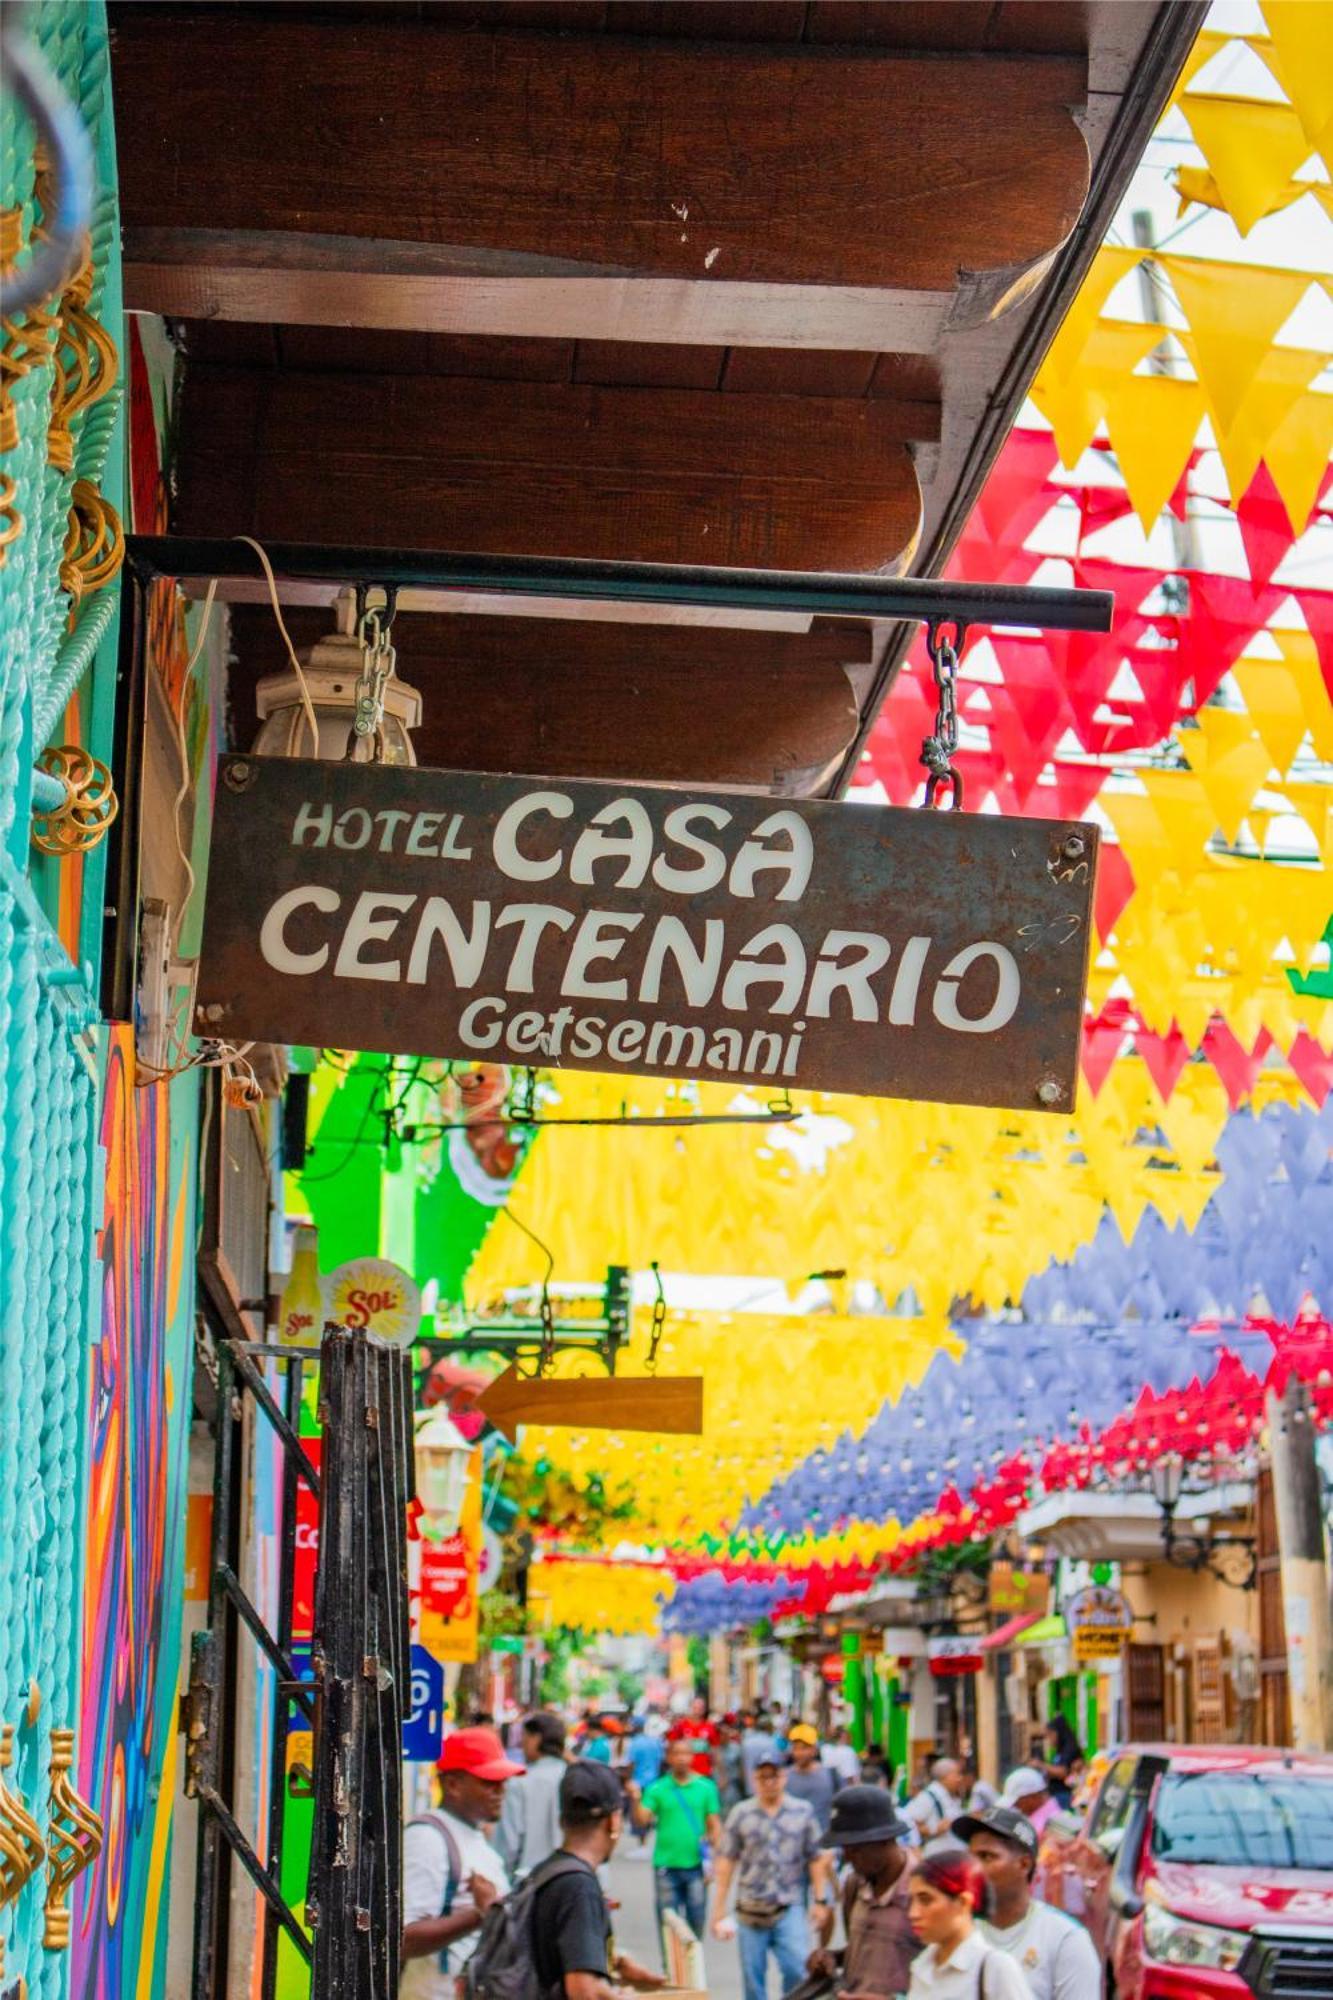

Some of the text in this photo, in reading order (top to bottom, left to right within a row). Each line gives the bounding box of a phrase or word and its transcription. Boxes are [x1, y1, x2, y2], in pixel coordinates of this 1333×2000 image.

[291, 791, 815, 904] HOTEL CASA
[259, 884, 1022, 1035] CENTENARIO
[456, 996, 806, 1078] Getsemani
